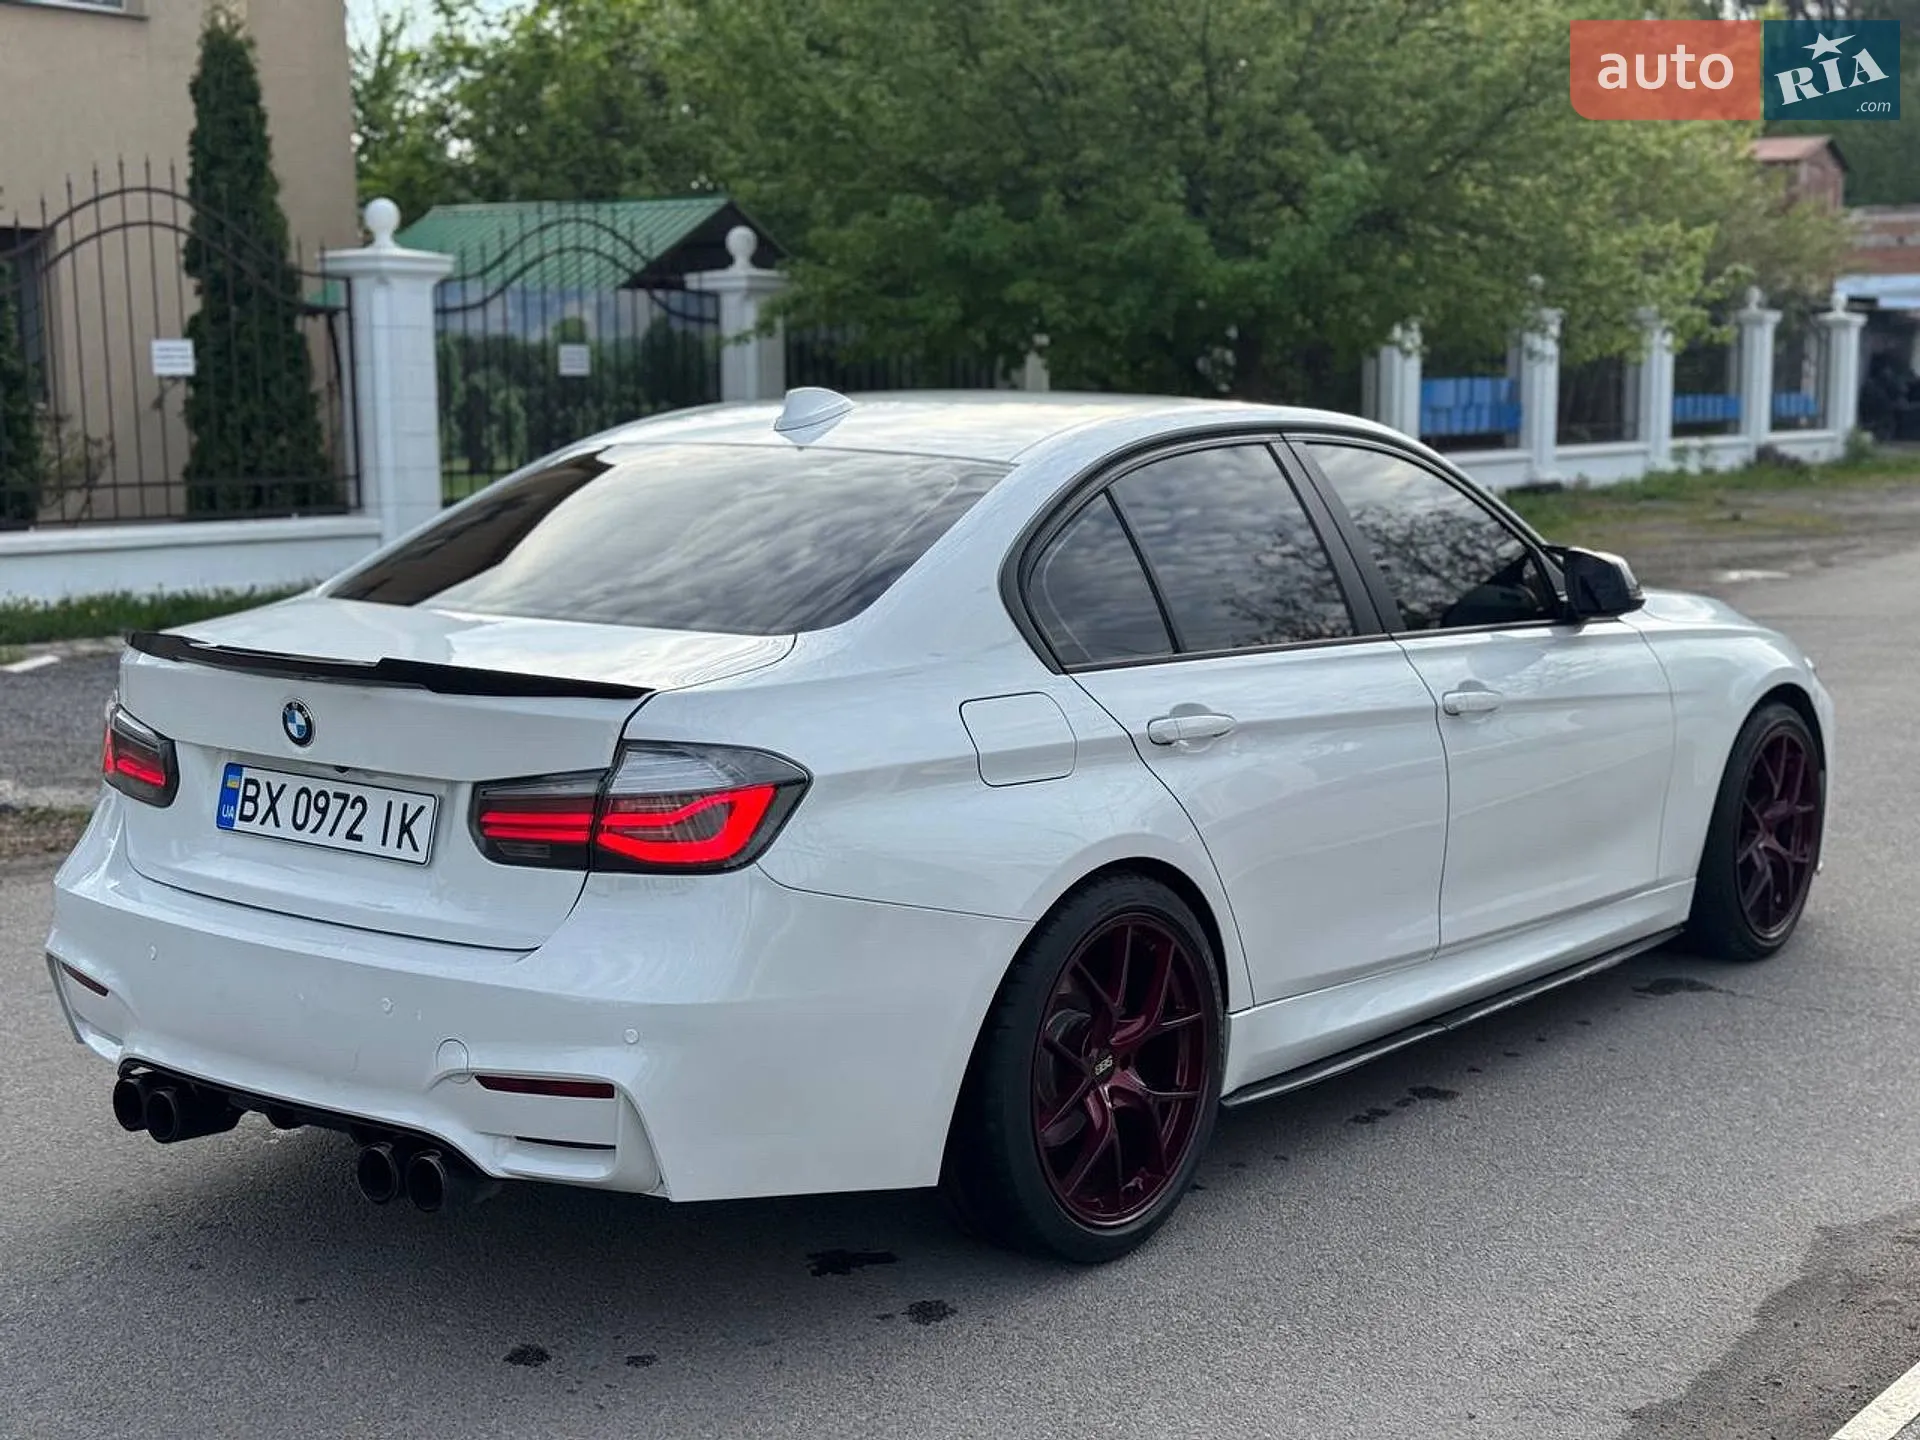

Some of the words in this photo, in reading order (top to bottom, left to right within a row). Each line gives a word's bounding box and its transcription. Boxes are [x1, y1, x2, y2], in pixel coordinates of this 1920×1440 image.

[238, 778, 287, 828] BX
[291, 786, 368, 842] 0972
[381, 800, 426, 852] IK
